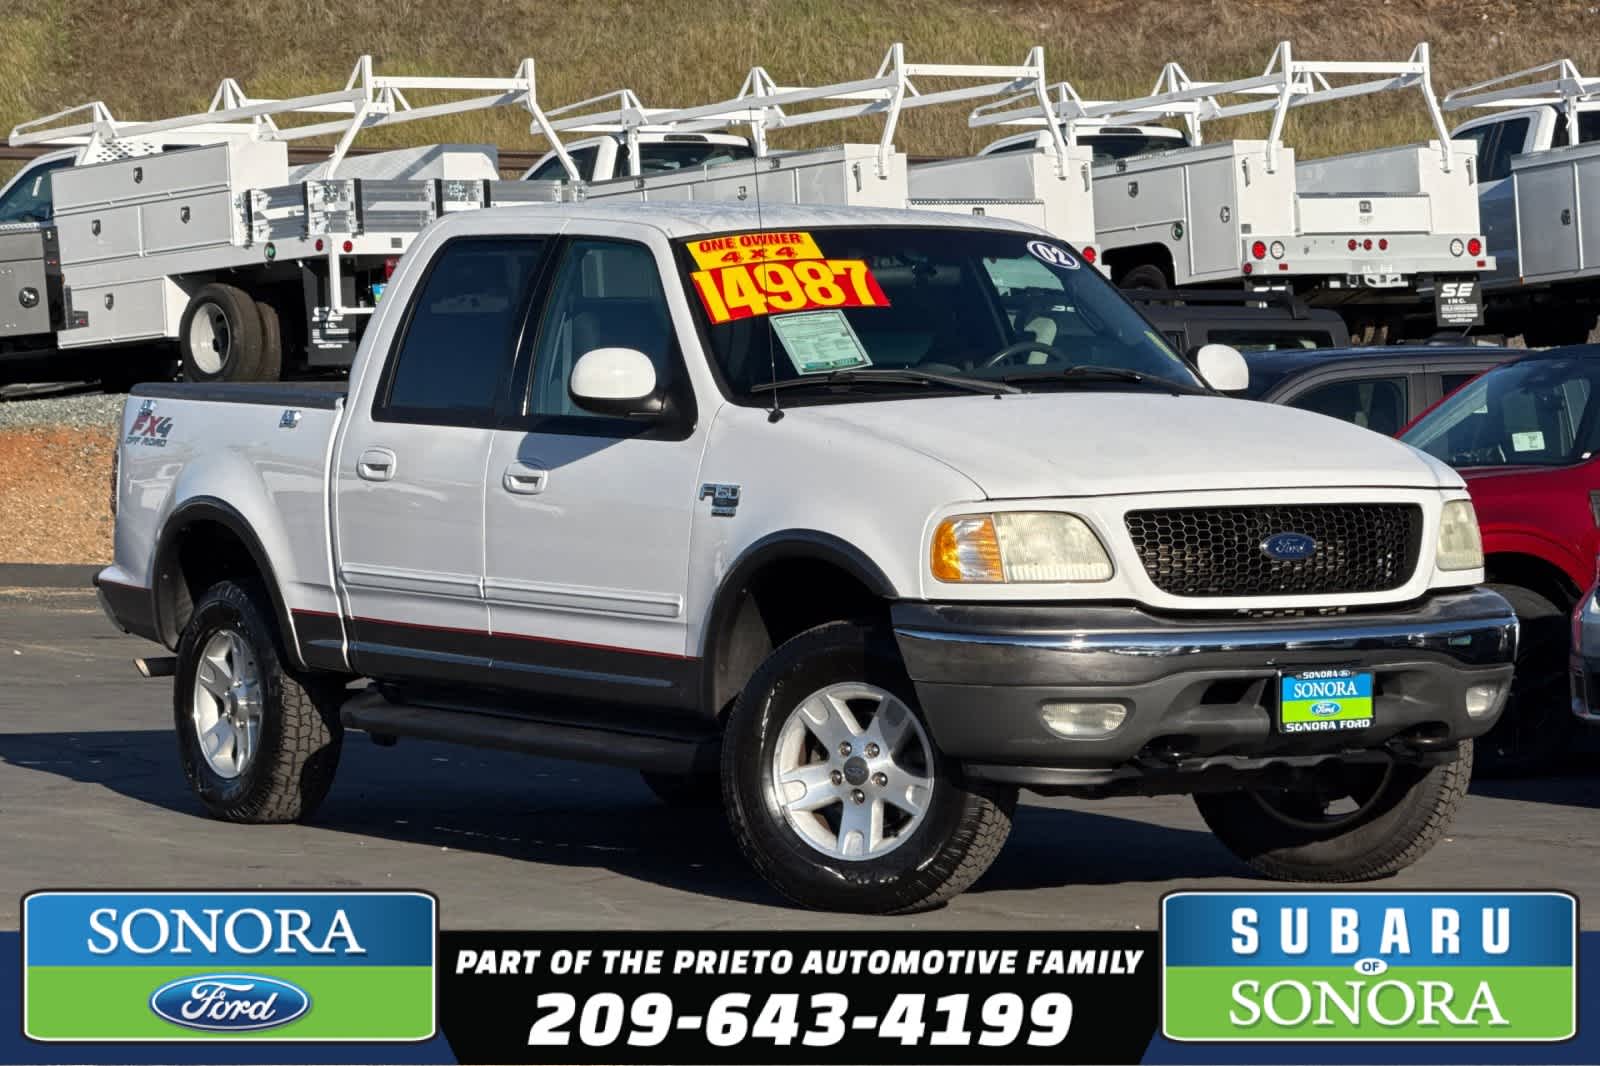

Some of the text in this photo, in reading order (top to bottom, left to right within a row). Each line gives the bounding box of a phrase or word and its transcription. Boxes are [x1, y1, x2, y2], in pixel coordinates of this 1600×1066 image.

[700, 232, 802, 252] ONE OWNER
[692, 260, 876, 322] 14987
[1440, 282, 1474, 297] SE
[129, 412, 173, 437] FX4
[1303, 670, 1338, 679] SONORA
[1294, 681, 1357, 698] SONORA
[1286, 719, 1370, 732] SONORA FORD
